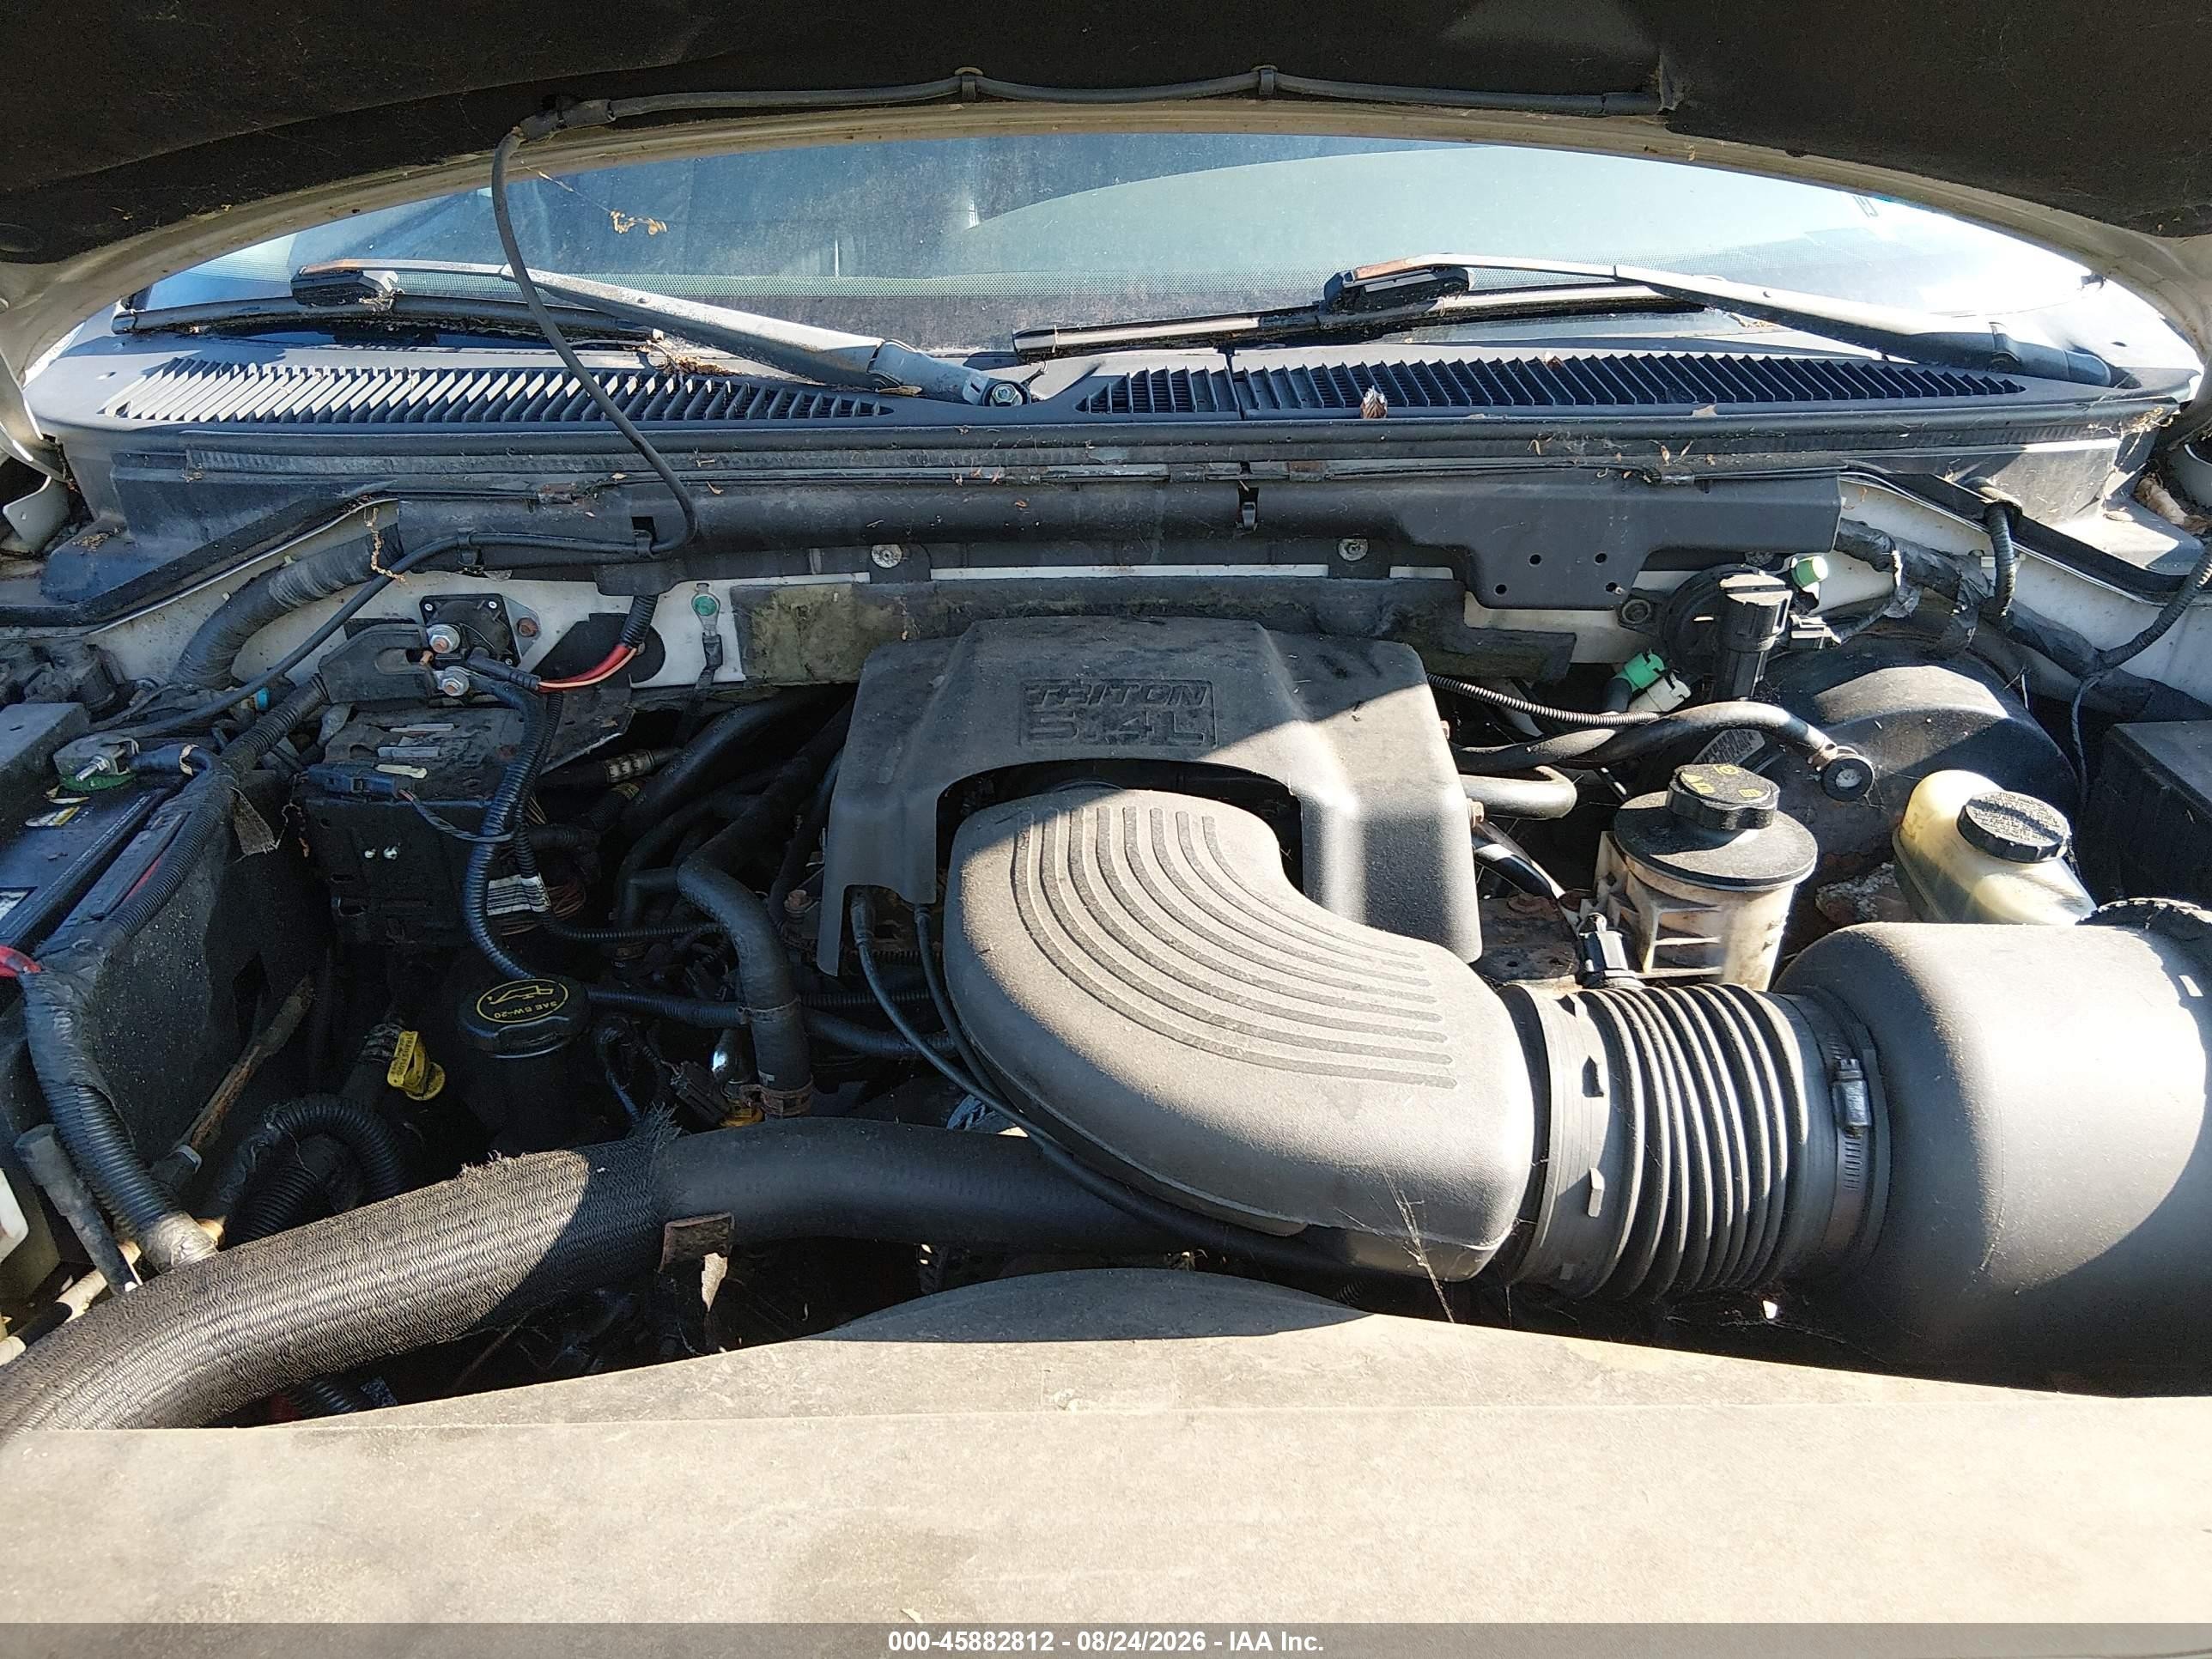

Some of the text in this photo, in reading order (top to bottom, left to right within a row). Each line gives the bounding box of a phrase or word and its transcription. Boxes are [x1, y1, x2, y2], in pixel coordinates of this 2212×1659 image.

[1028, 684, 1212, 707] TRITON
[1028, 709, 1205, 745] 5.4L
[535, 1000, 557, 1011] SAE
